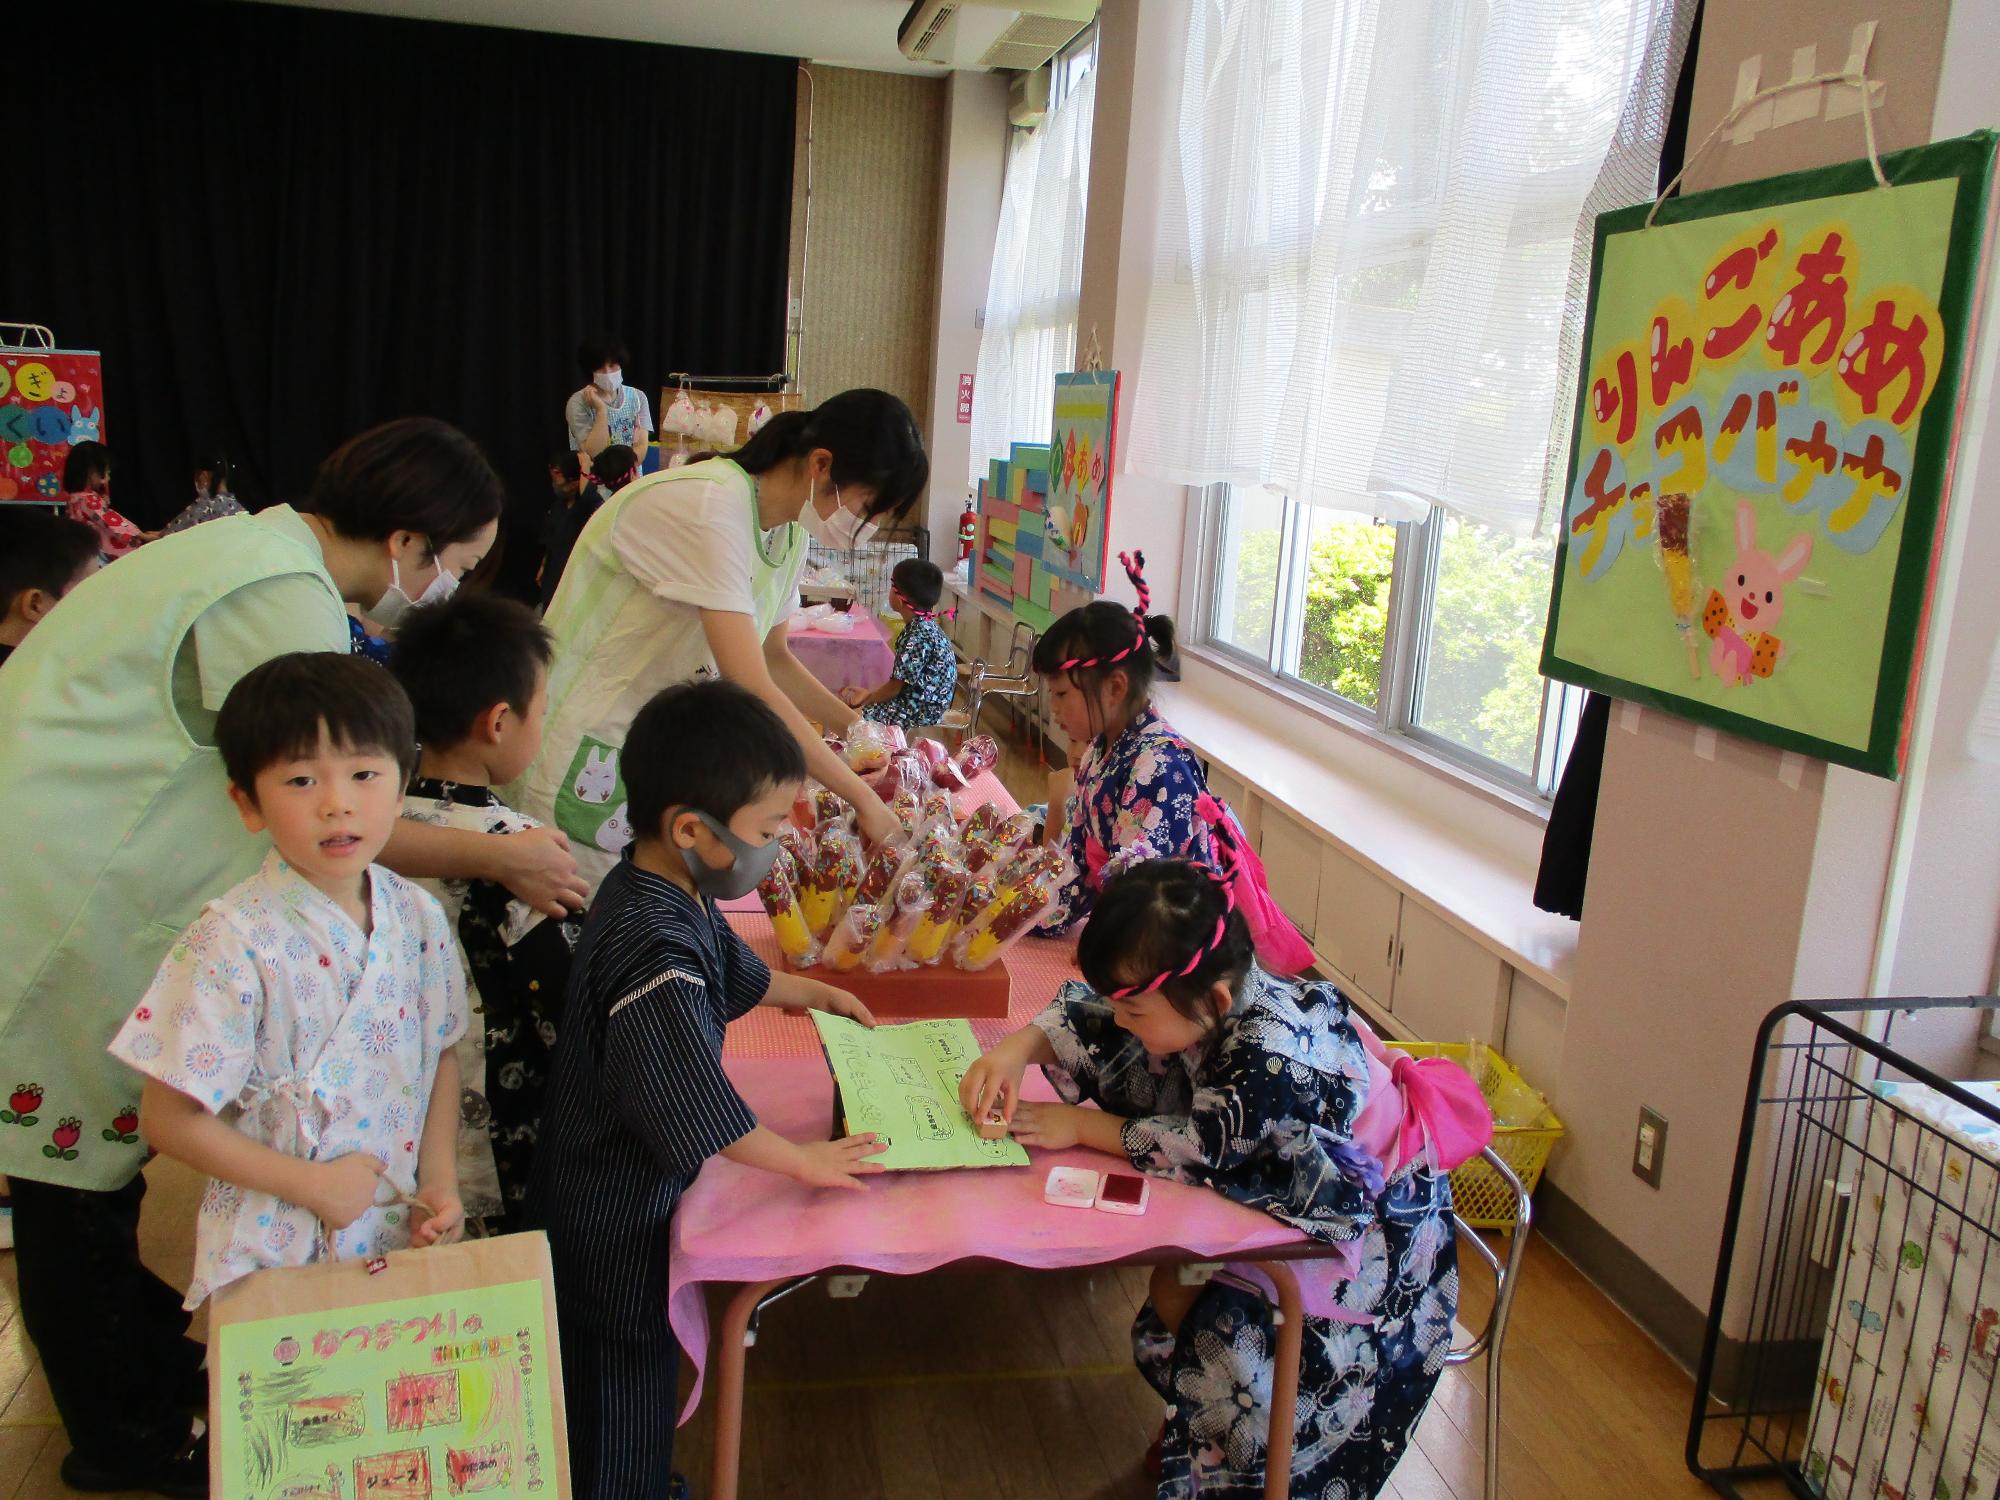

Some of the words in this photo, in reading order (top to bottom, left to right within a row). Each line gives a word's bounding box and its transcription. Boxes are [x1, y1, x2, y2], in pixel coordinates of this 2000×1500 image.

[1594, 228, 1928, 444] りんごあめ
[0, 370, 68, 400] ぎょ
[959, 375, 972, 413] 消火器
[1571, 382, 1903, 577] チョコバナナ
[312, 1308, 457, 1360] なつまつり
[366, 1468, 418, 1490] ジュース
